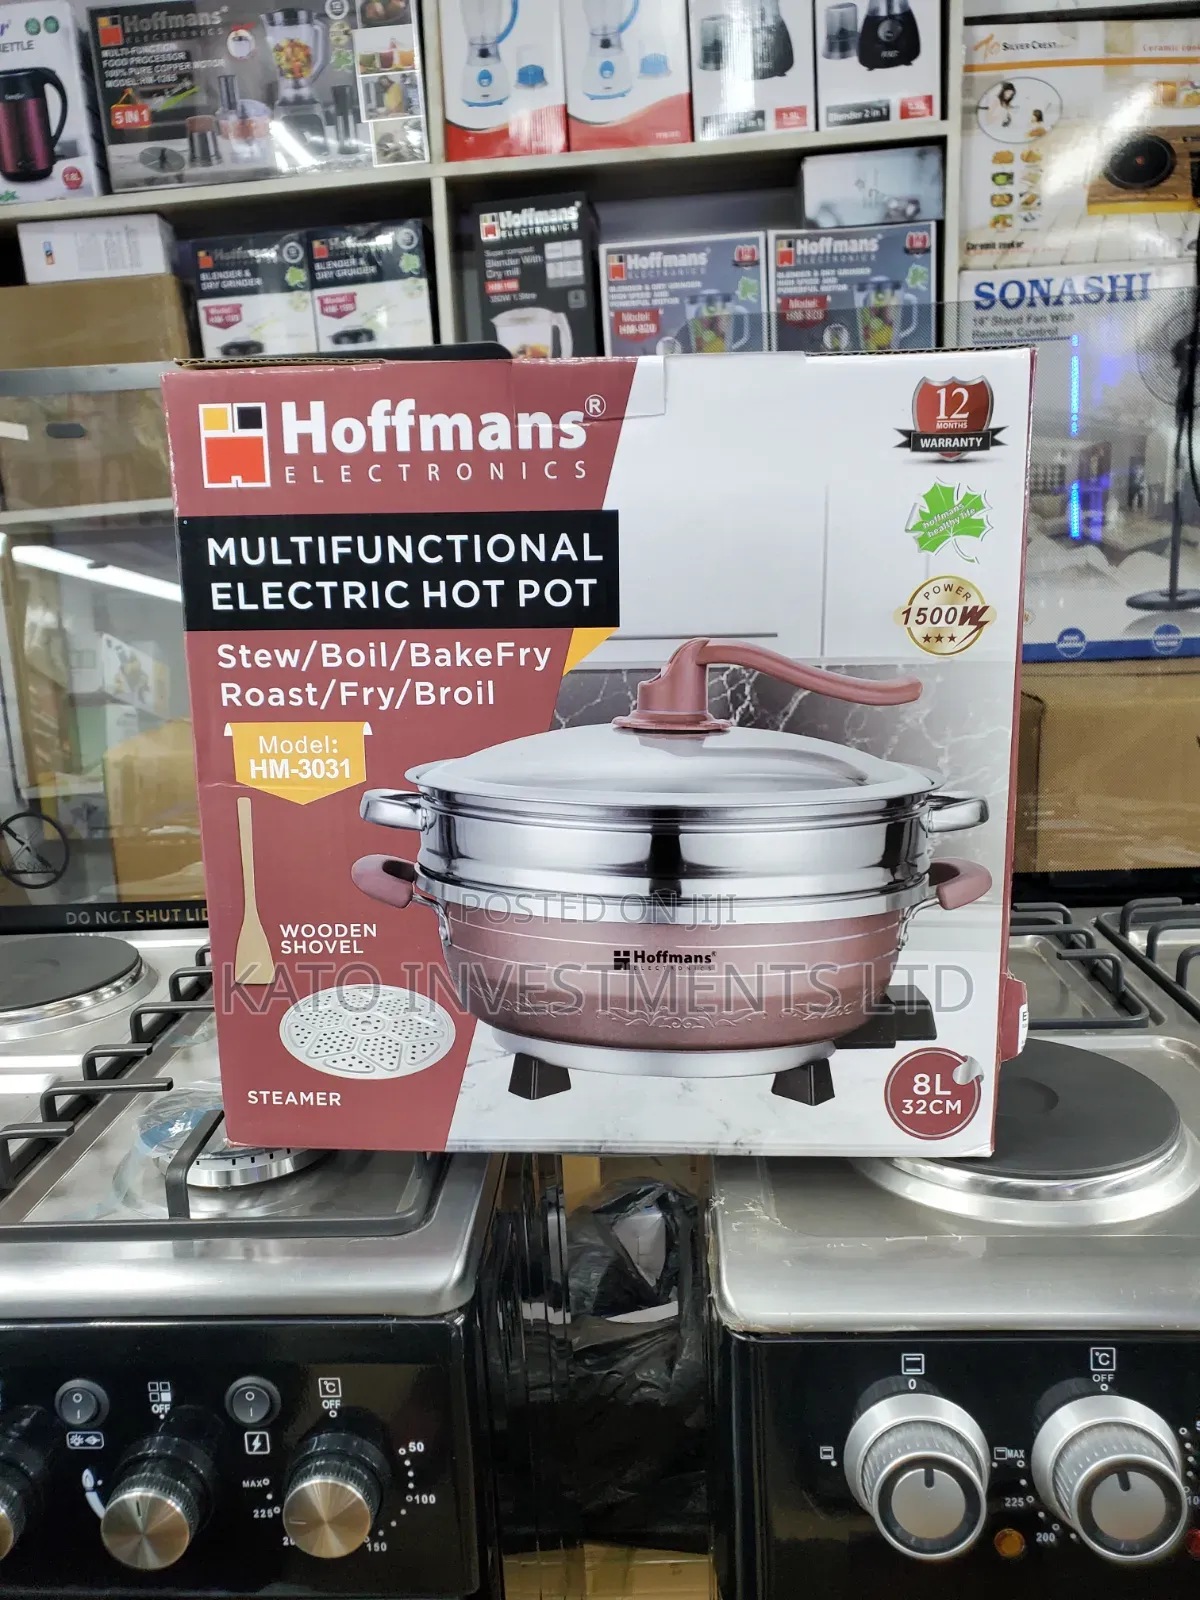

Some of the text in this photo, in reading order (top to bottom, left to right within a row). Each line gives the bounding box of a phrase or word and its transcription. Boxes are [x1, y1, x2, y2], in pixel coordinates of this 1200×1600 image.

[114, 109, 150, 124] 5 IN 1
[500, 206, 579, 228] Hoffmans
[796, 237, 879, 255] Hoffmans
[627, 251, 708, 269] Hoffmans
[974, 272, 1151, 310] SONASHI
[935, 387, 970, 420] 12
[936, 421, 968, 430] MONTHS
[920, 436, 983, 449] WARRANTY
[285, 460, 587, 484] ELECTRONICS
[922, 503, 965, 529] hoffmans
[927, 507, 976, 538] healthy life
[207, 532, 604, 566] MULTIFUNCTIONAL
[210, 578, 598, 612] ELECTRIC HOT POT
[923, 582, 972, 602] POWER
[901, 604, 990, 629] 1500W
[217, 640, 552, 673] Stew/Boil/BakeFry
[220, 679, 495, 710] Roast/Fry/Broil
[258, 735, 339, 755] Model:
[249, 759, 351, 780] HM-3031
[66, 911, 90, 925] DO
[136, 909, 181, 923] SHUT
[279, 923, 377, 938] WOODEN
[280, 939, 364, 955] SHOVEL
[913, 1073, 951, 1096] 8L
[247, 1090, 341, 1106] STEAMER
[901, 1099, 962, 1115] 32CM
[1092, 1374, 1115, 1383] OFF
[151, 1404, 170, 1414] OFF
[322, 1400, 341, 1409] OFF
[408, 1442, 425, 1452] 50
[1007, 1449, 1025, 1459] MAX
[242, 1480, 263, 1488] MAX
[413, 1494, 436, 1504] 100
[1004, 1498, 1024, 1508] 225
[253, 1509, 273, 1518] 225
[1036, 1532, 1056, 1542] 200
[366, 1543, 387, 1552] 150
